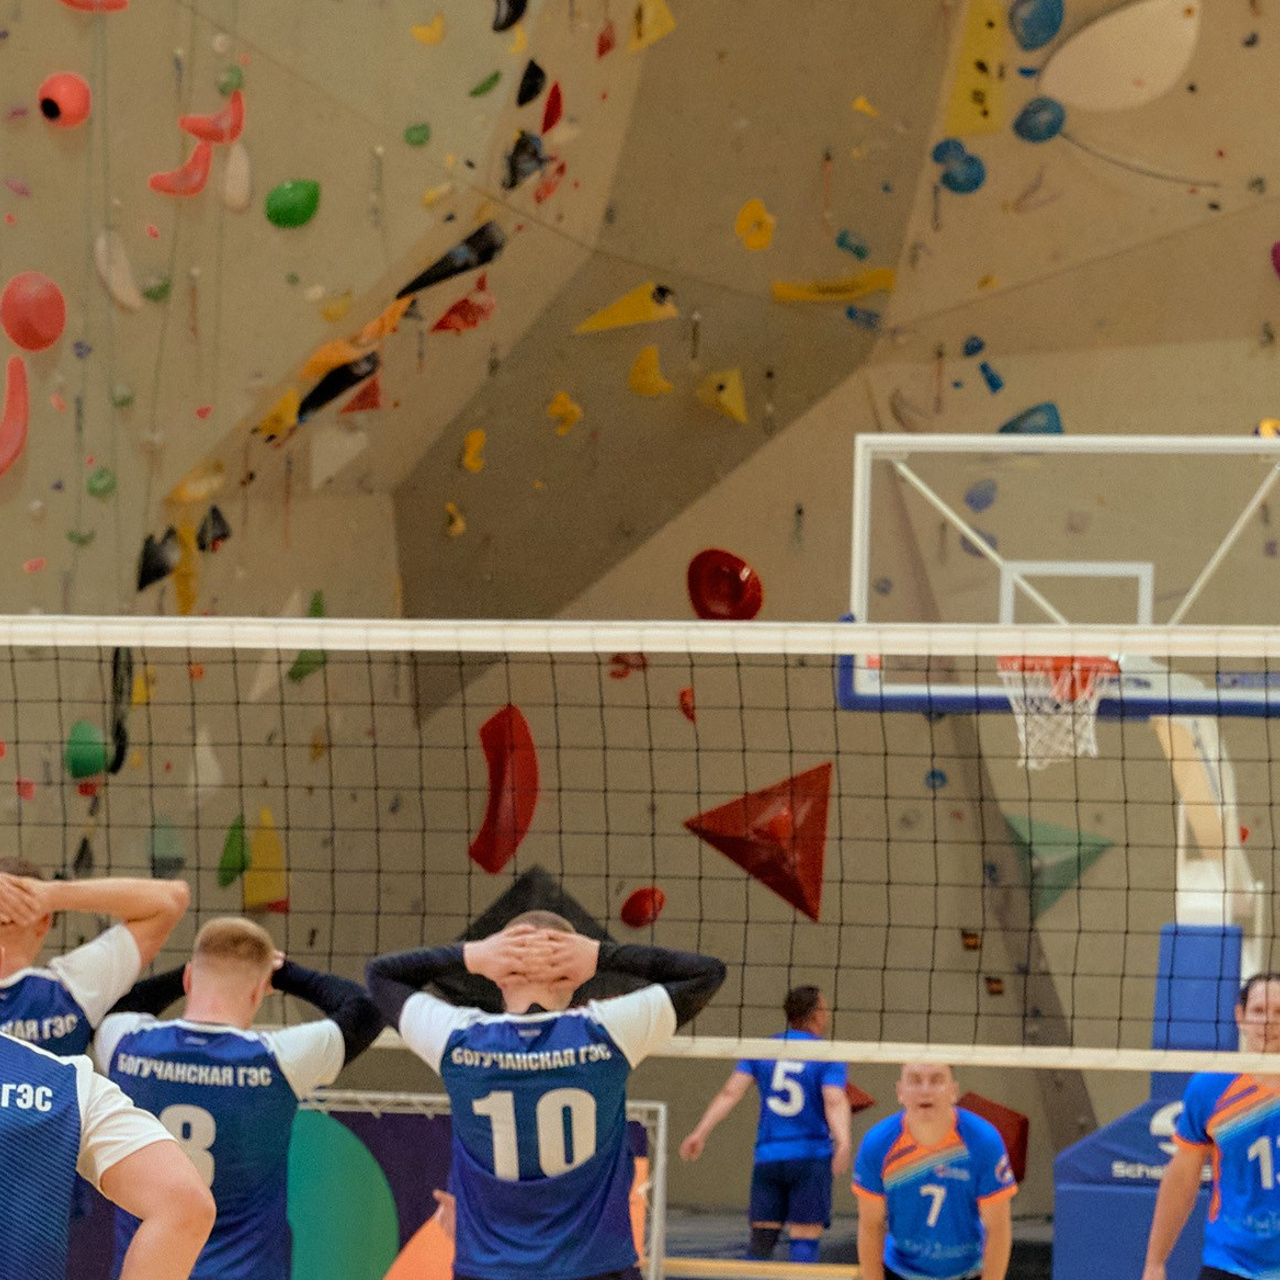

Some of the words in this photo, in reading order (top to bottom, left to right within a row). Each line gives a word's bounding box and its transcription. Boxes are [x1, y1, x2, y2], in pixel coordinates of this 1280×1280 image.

[118, 1053, 234, 1086] БОГУЧАНСКАЯ
[237, 1066, 272, 1087] ГЭС
[766, 1060, 805, 1117] 5
[1, 1083, 53, 1112] ГЭС
[472, 1087, 596, 1181] 10
[1112, 1161, 1167, 1179] Sche
[1248, 1136, 1280, 1190] 1
[920, 1184, 946, 1227] 7
